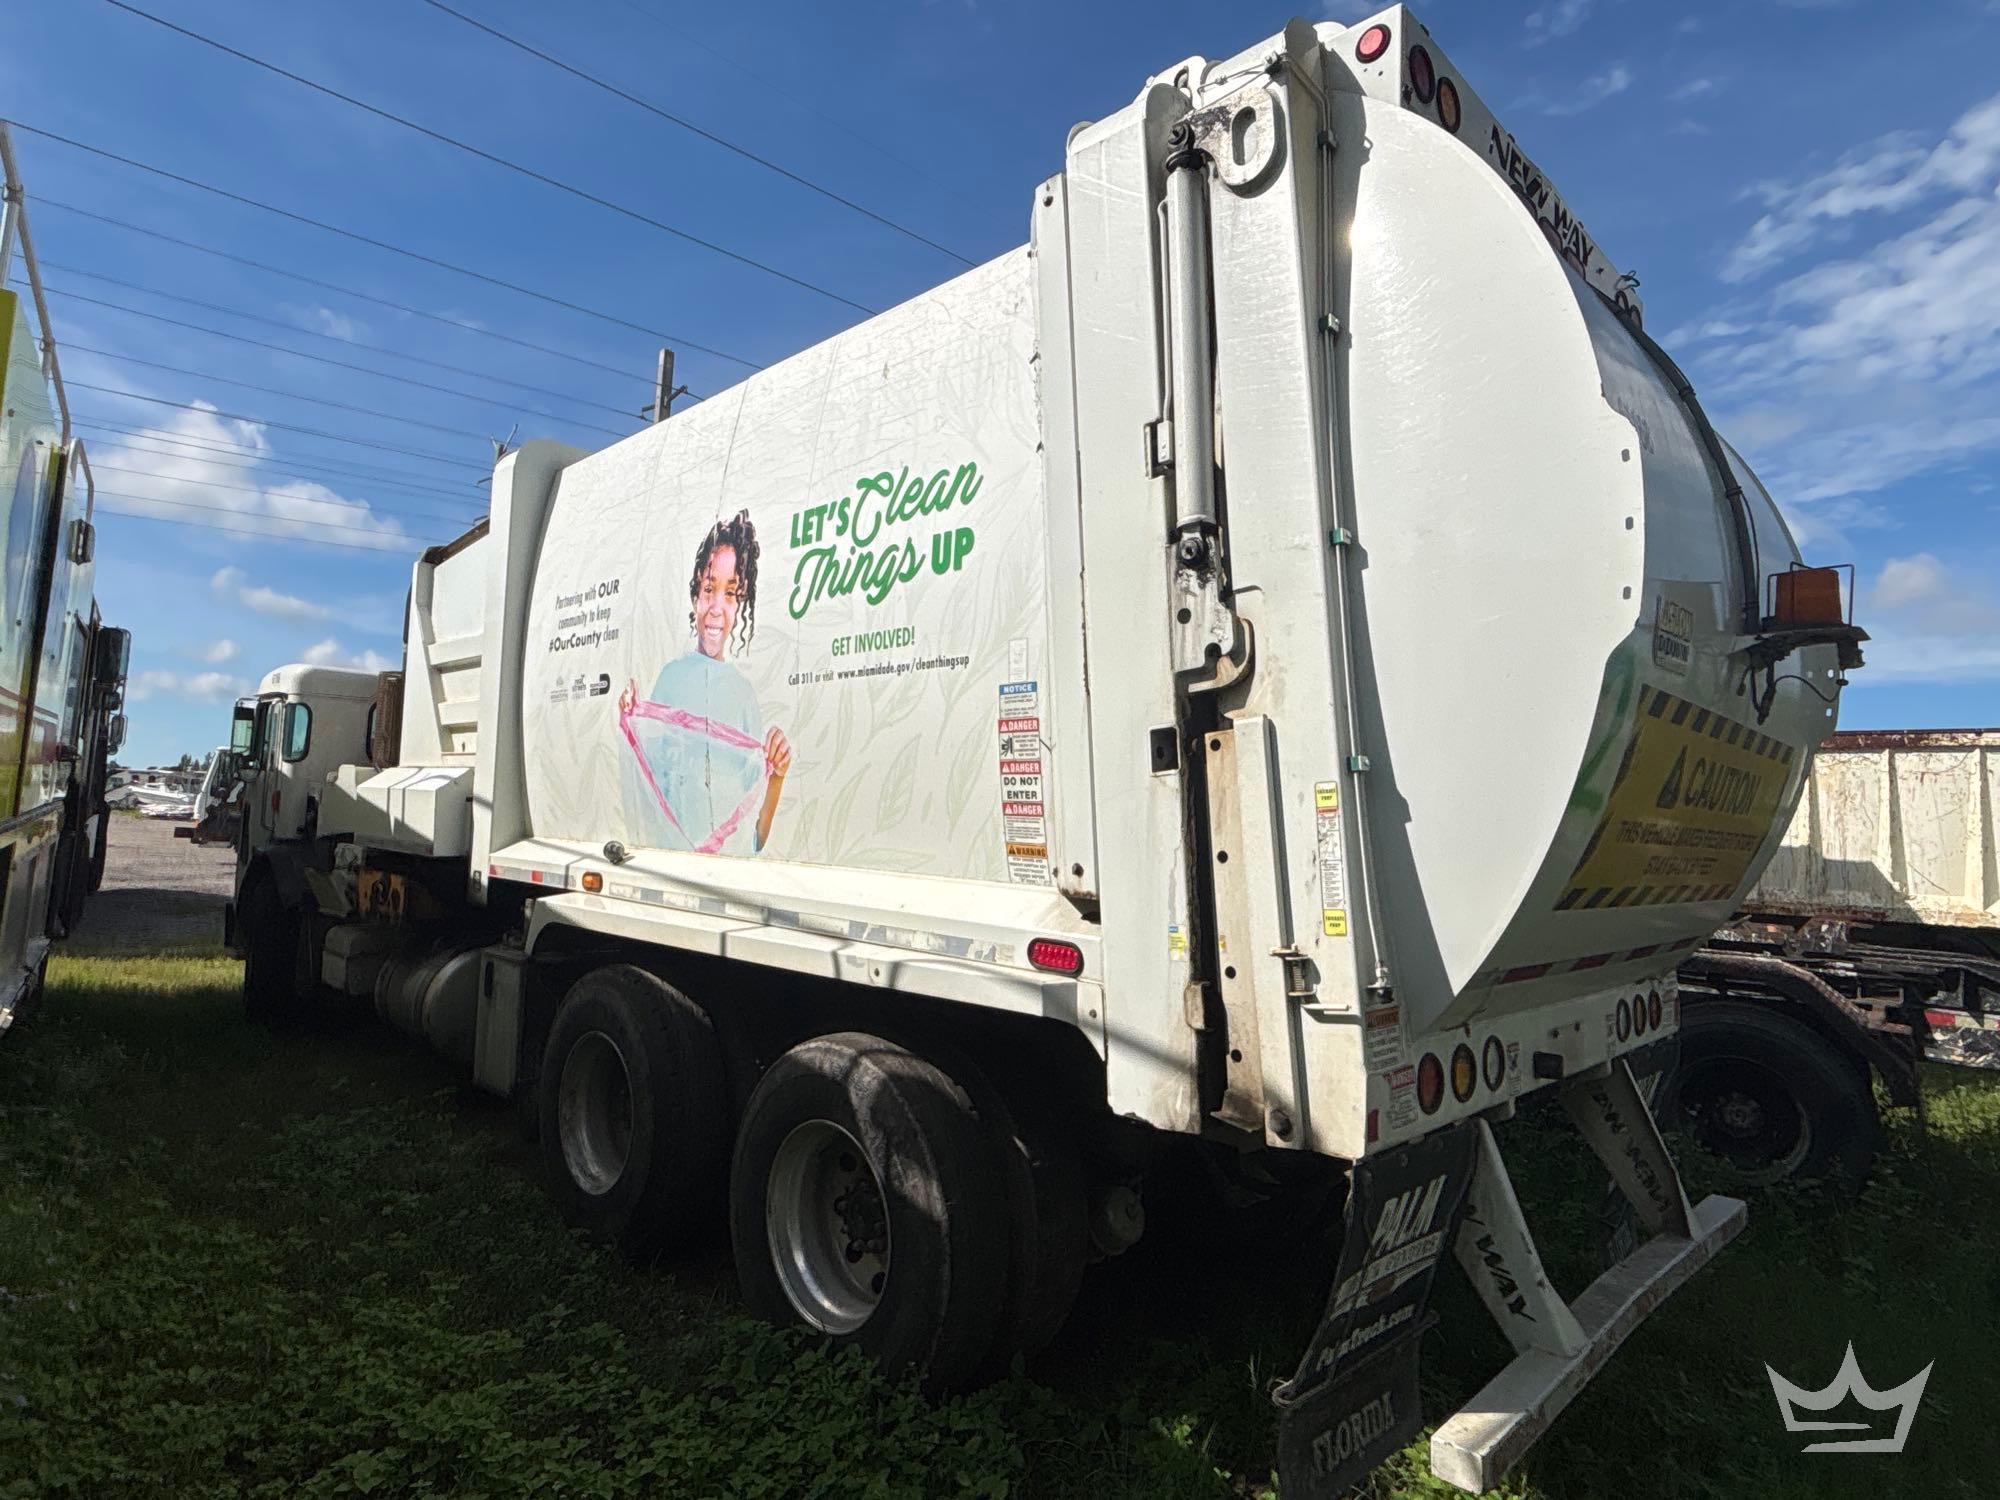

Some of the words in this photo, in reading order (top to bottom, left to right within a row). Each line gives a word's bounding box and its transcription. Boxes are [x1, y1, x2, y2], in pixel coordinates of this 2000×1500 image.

[1489, 123, 1552, 209] NEW
[1554, 201, 1594, 266] WAY
[790, 497, 851, 549] LET'S
[851, 461, 984, 548] Clean
[789, 537, 927, 620] Things
[931, 527, 975, 575] UP
[585, 584, 597, 600] with
[598, 579, 620, 598] OUR
[558, 610, 588, 630] community
[589, 609, 595, 622] to
[596, 604, 611, 622] keep
[549, 630, 602, 653] #OurCounty
[603, 624, 619, 641] clean
[832, 636, 852, 657] GET
[854, 625, 916, 654] INVOLVED!
[788, 674, 800, 686] Call
[801, 671, 813, 684] 311
[815, 674, 821, 682] or
[822, 670, 834, 681] visit
[838, 655, 970, 680] www.miamidade.gov/cleanthingsup
[1003, 683, 1033, 694] NOTICE
[1008, 720, 1039, 732] DANGER
[1009, 762, 1040, 773] DANGER
[1003, 777, 1017, 786] DO
[1019, 776, 1039, 786] NOT
[1684, 757, 1762, 816] CAUTION
[1006, 790, 1038, 800] ENTER
[1012, 804, 1043, 816] DANGER
[1015, 846, 1046, 858] WARNING
